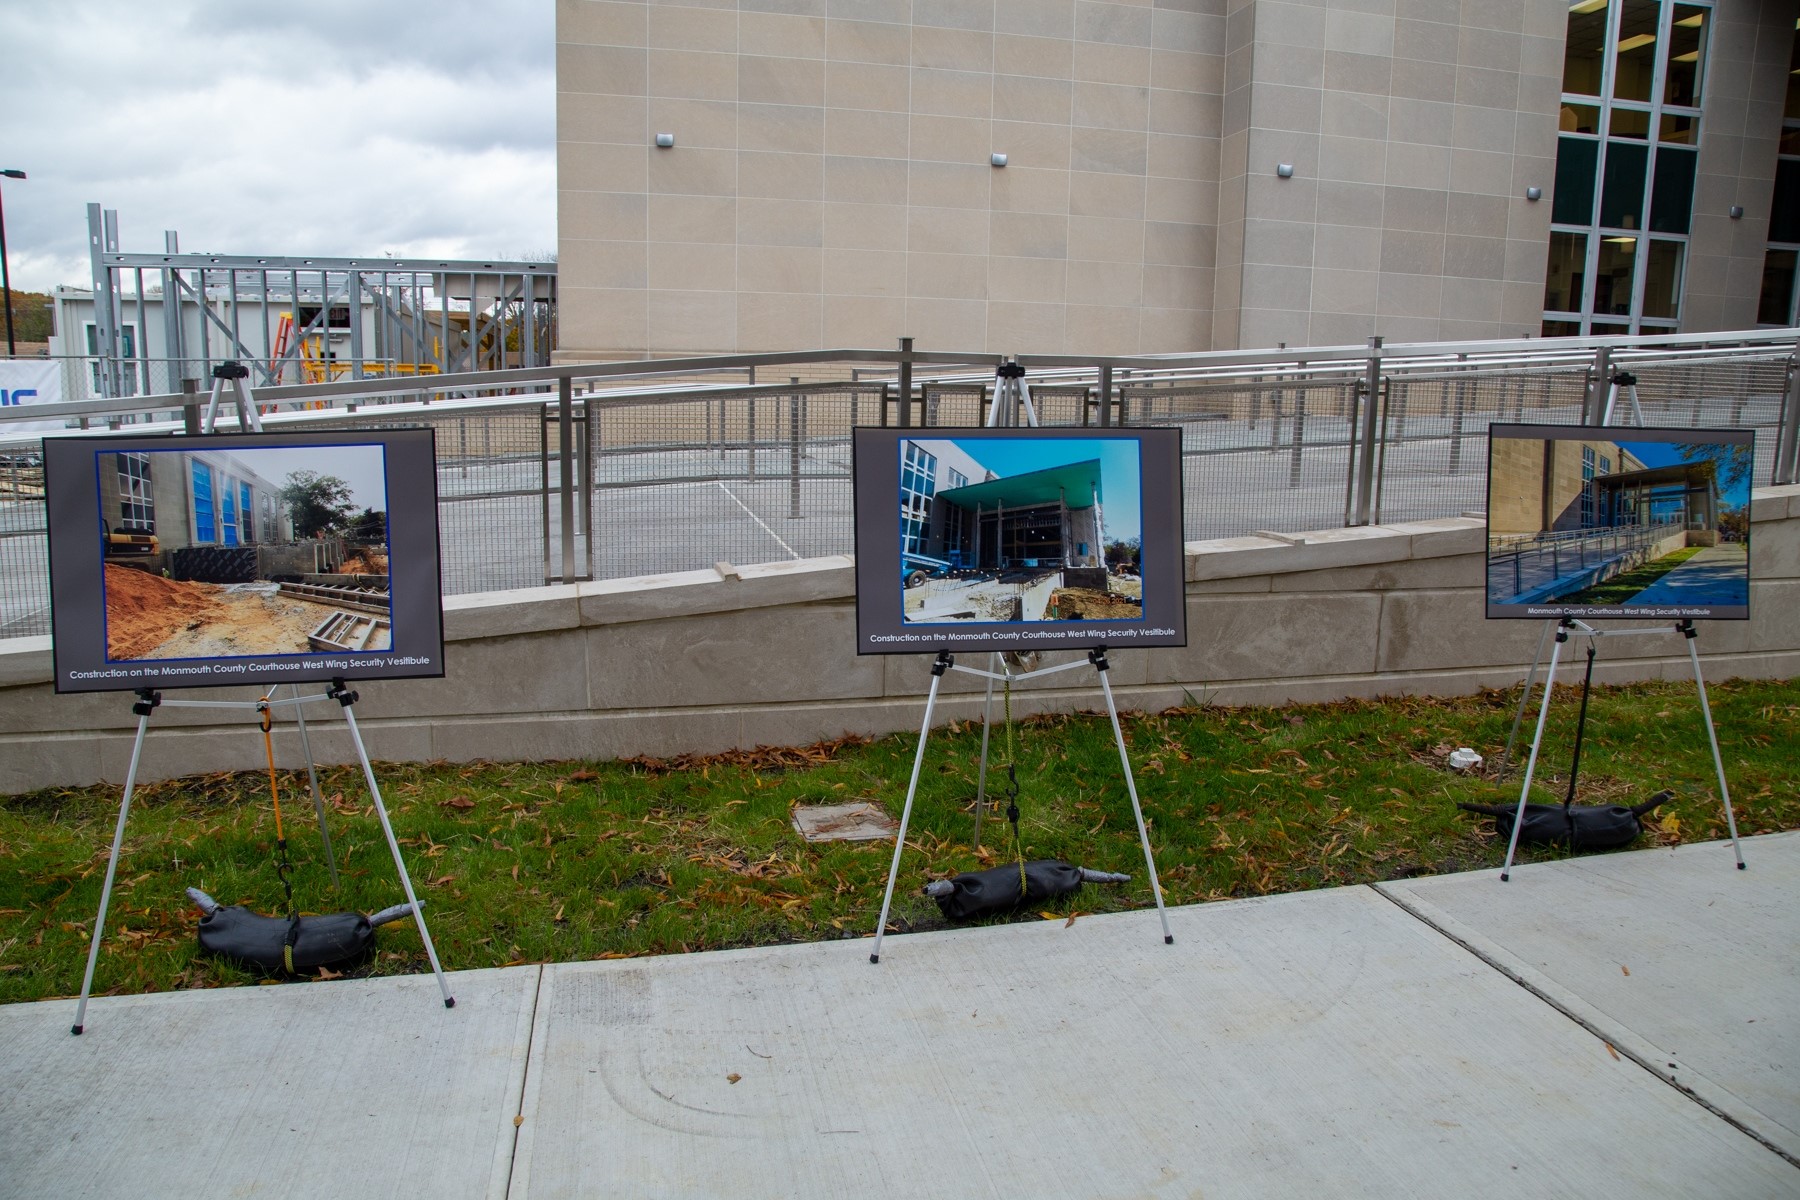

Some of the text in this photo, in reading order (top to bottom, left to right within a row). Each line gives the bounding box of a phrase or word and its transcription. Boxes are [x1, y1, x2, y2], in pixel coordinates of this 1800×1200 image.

[1563, 608, 1586, 616] County
[1640, 608, 1656, 616] Wing
[1656, 608, 1680, 616] Security
[870, 633, 920, 643] Construction
[933, 633, 947, 641] the
[948, 632, 991, 640] Monmouth
[992, 631, 1020, 641] County
[1021, 631, 1066, 639] Courthouse
[1067, 630, 1086, 638] West
[1087, 629, 1106, 639] Wing
[1107, 628, 1137, 638] Security
[69, 668, 128, 679] Construction
[129, 669, 143, 677] on
[144, 667, 159, 677] the
[161, 664, 211, 675] Monmouth
[213, 663, 247, 674] County
[248, 662, 300, 673] Courthouse
[302, 660, 324, 670] West
[325, 659, 348, 670] Wing
[349, 657, 385, 669] Security
